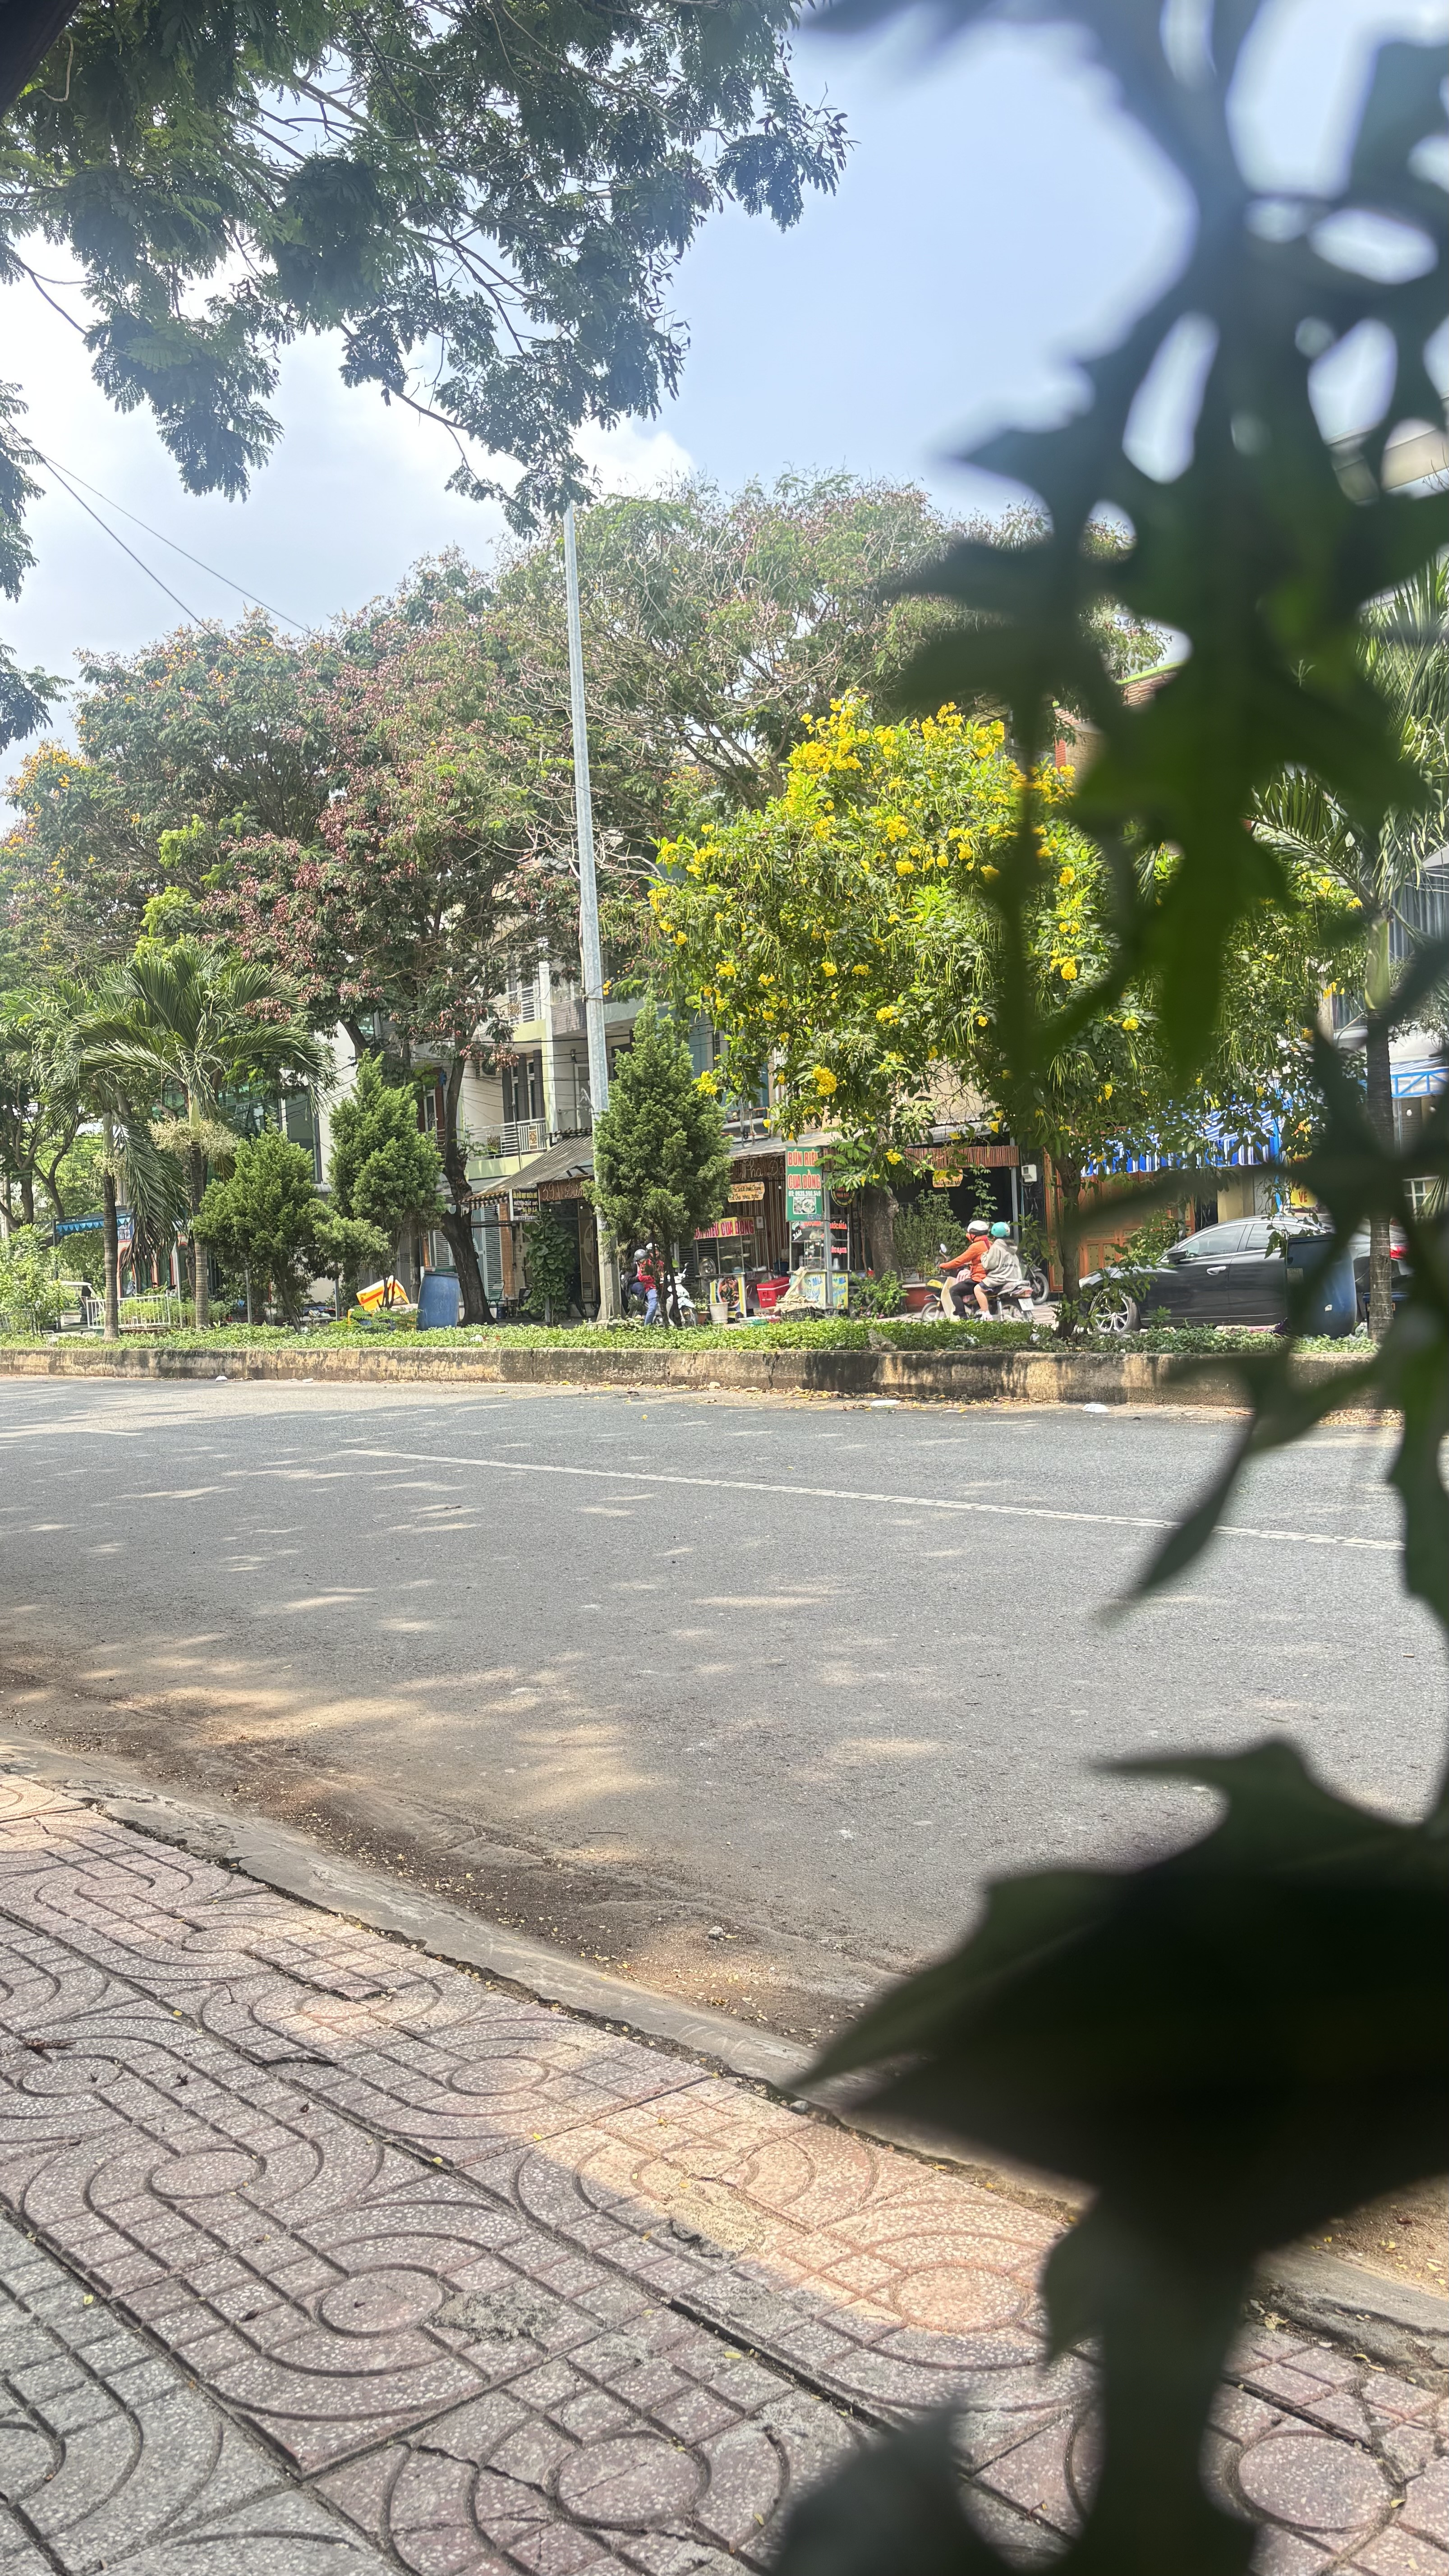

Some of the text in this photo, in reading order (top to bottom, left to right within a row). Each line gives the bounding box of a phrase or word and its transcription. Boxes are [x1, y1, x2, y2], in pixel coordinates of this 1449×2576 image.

[787, 1149, 803, 1166] BÚN
[788, 1174, 802, 1189] CUA
[721, 1220, 733, 1236] CUA
